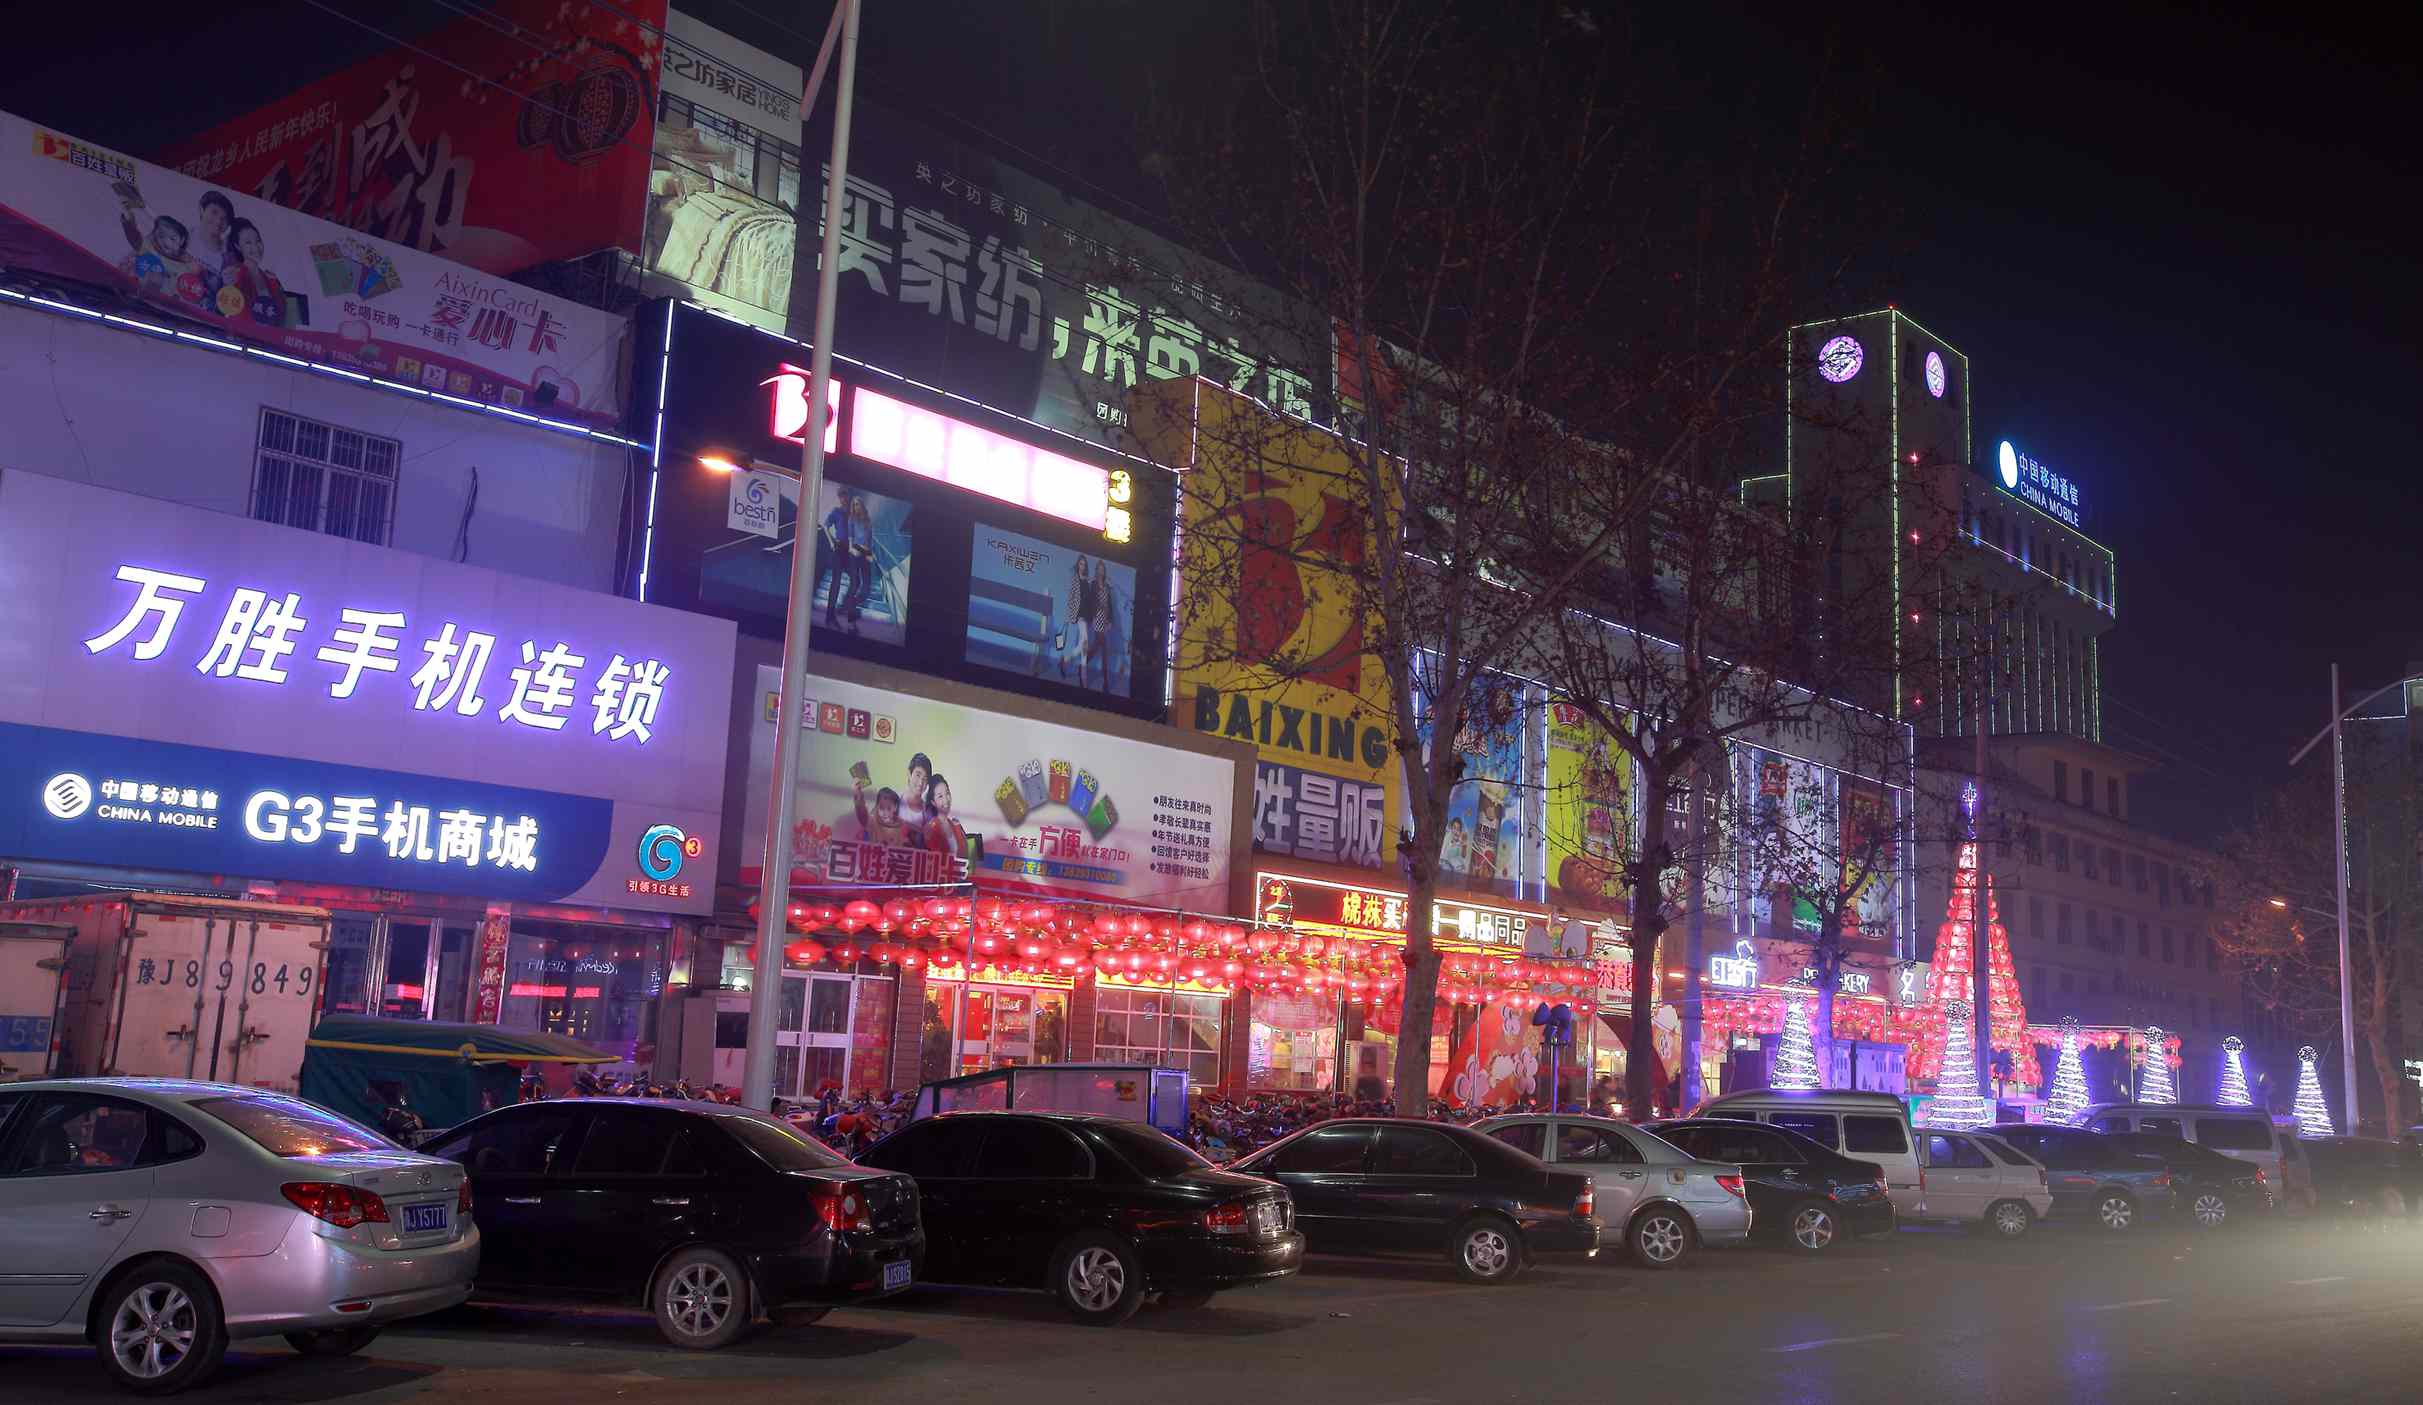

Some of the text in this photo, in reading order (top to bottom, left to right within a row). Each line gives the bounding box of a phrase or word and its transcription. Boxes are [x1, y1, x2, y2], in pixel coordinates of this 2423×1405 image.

[434, 271, 540, 317] AixinCard
[344, 300, 460, 347] 吃喝玩购 一卡通行
[432, 293, 568, 355] 爱心卡
[2019, 452, 2079, 507] 中国移动通信
[2020, 481, 2081, 528] CHINA MOBILE
[83, 565, 670, 745] 万胜手机连锁
[1195, 685, 1387, 770] BAIXING
[97, 803, 218, 829] CHINA MOBILE
[100, 779, 219, 812] 中国移动通信
[1158, 795, 1212, 815] 朋友往来真时尚
[1252, 766, 1384, 870] 姓量贩
[243, 789, 538, 872] G3手机商城
[1157, 829, 1210, 849] 年节送礼真方便
[627, 878, 692, 898] 引领3G生活
[136, 957, 313, 997] 豫J89849
